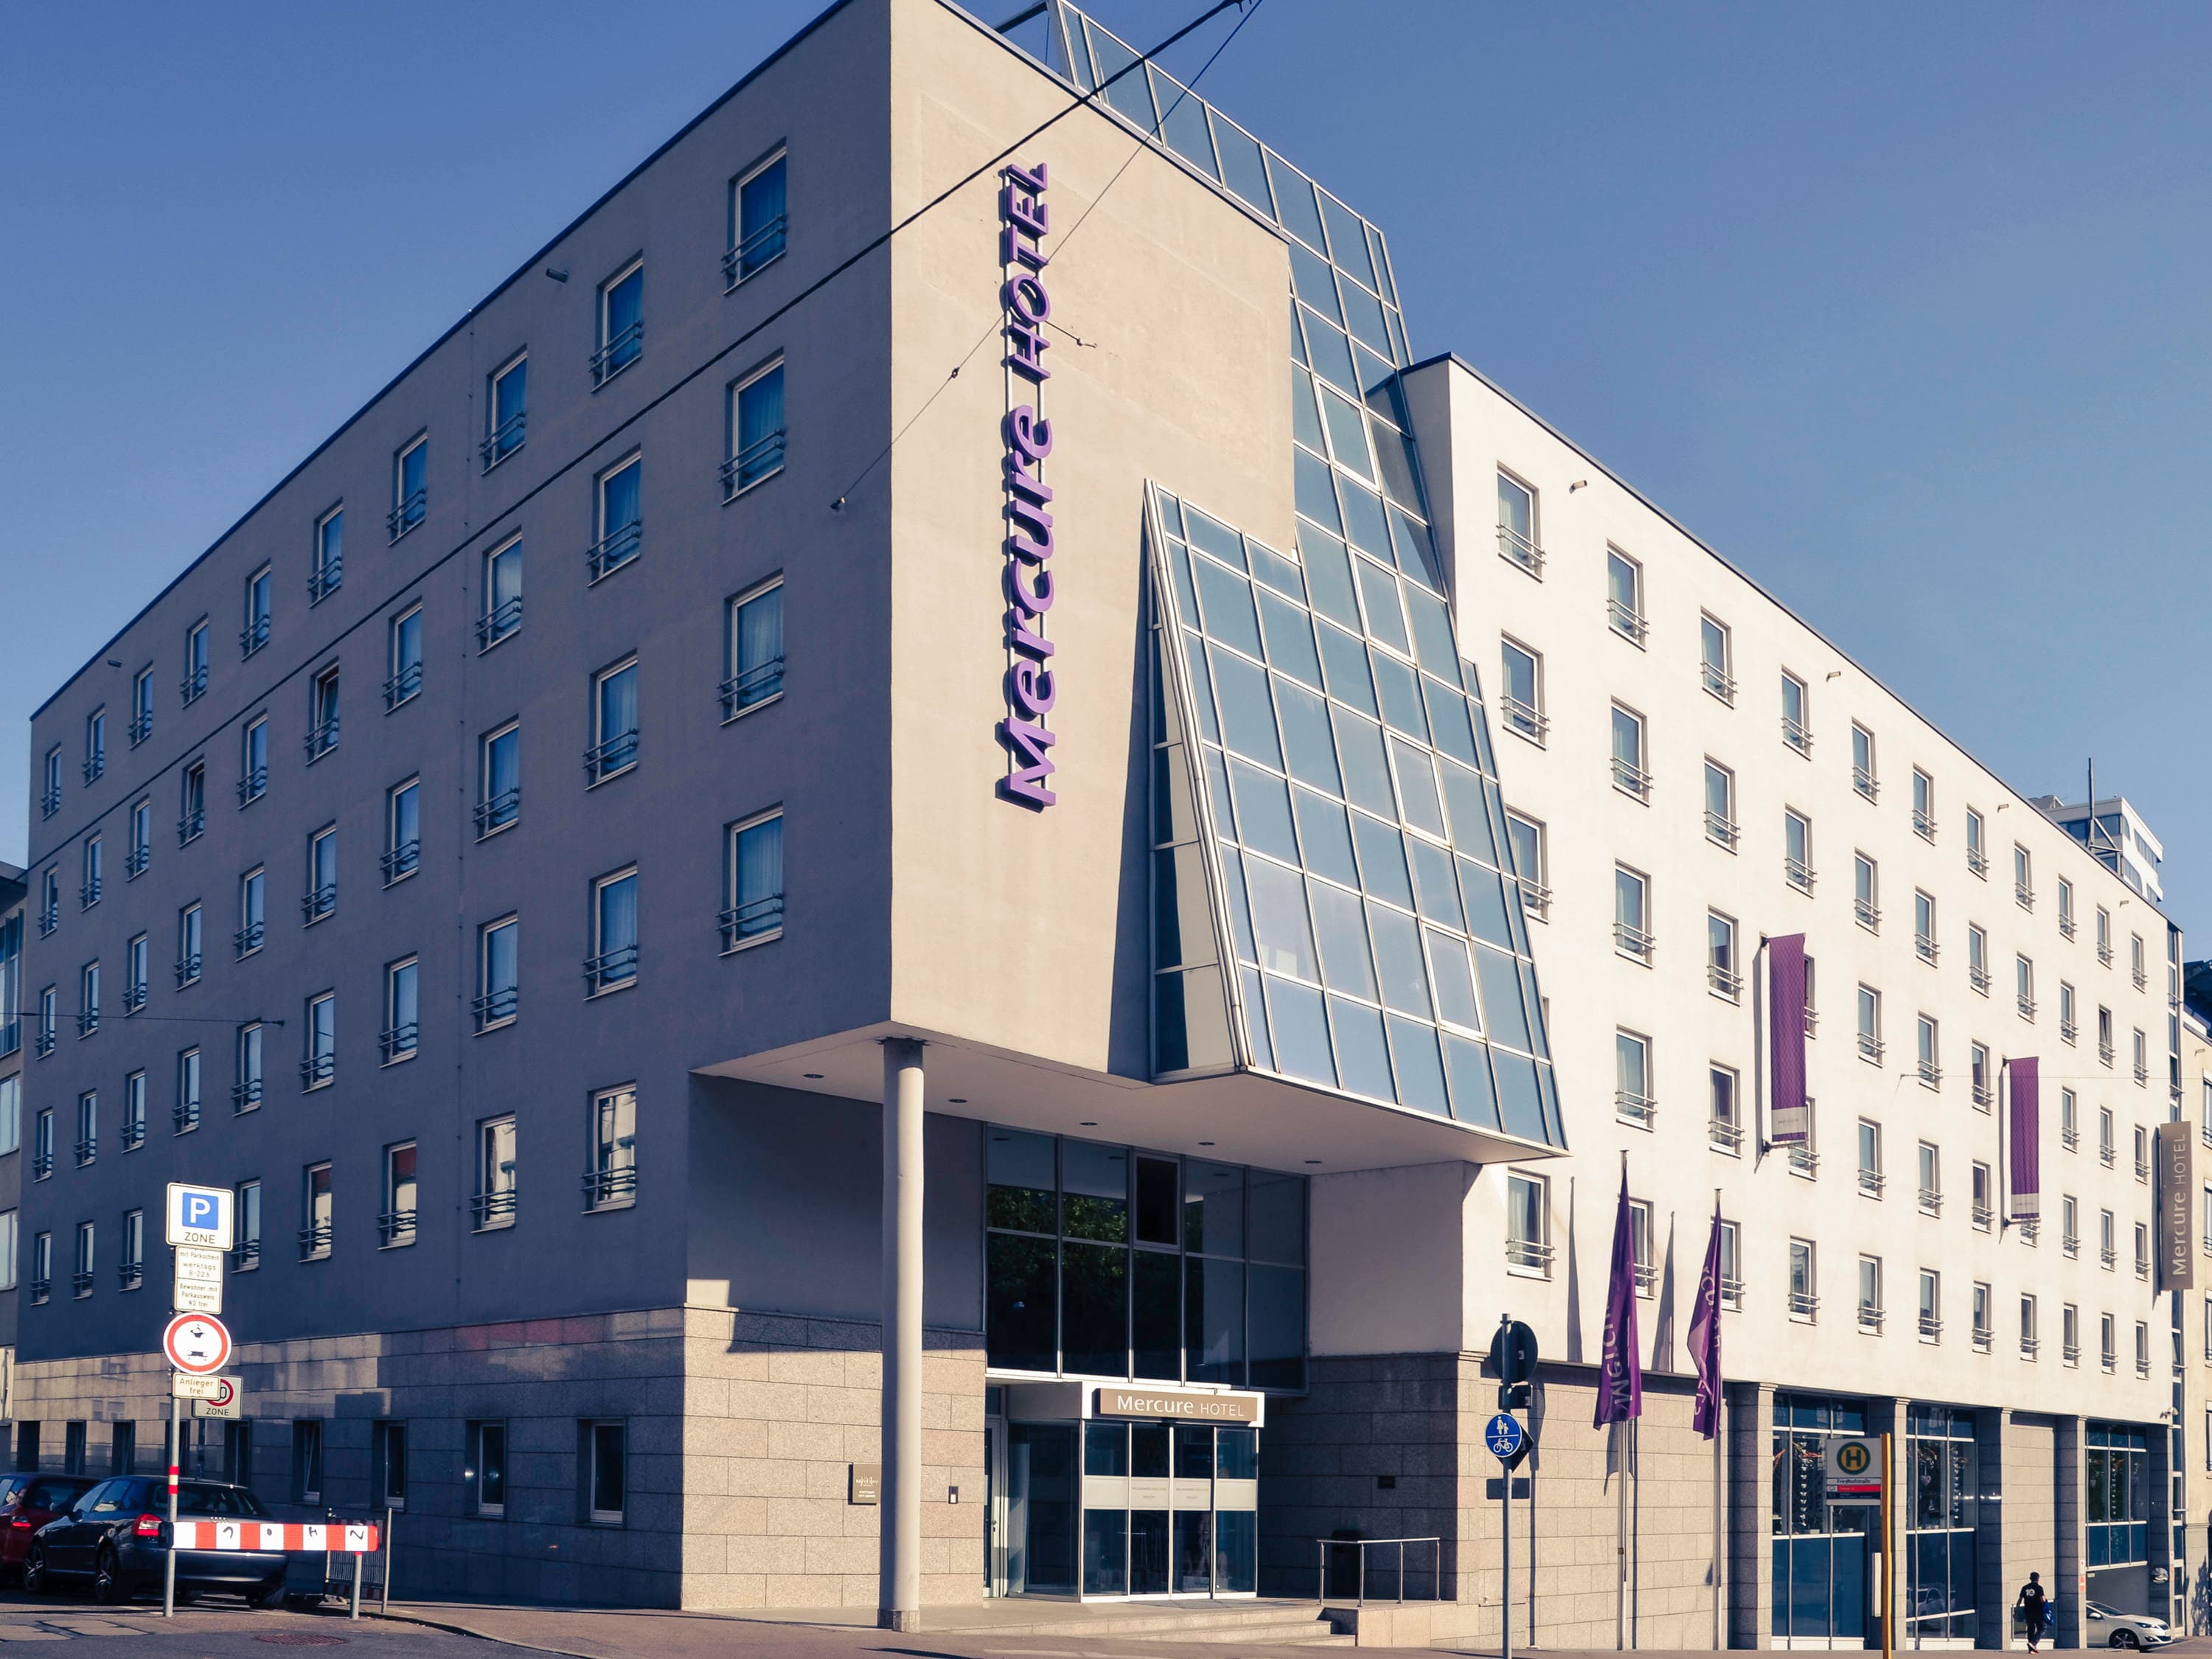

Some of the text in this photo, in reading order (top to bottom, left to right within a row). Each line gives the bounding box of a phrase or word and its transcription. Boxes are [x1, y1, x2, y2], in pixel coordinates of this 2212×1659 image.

[1006, 162, 1057, 808] Mercure HOTEL
[190, 1197, 211, 1224] P
[2172, 1133, 2187, 1276] Mercure HOTEL
[184, 1232, 216, 1244] ZONE
[183, 1262, 216, 1271] werktags
[179, 1378, 214, 1386] Anlieger
[206, 1408, 229, 1416] ZONE
[1117, 1395, 1245, 1416] Mercure HOTEL
